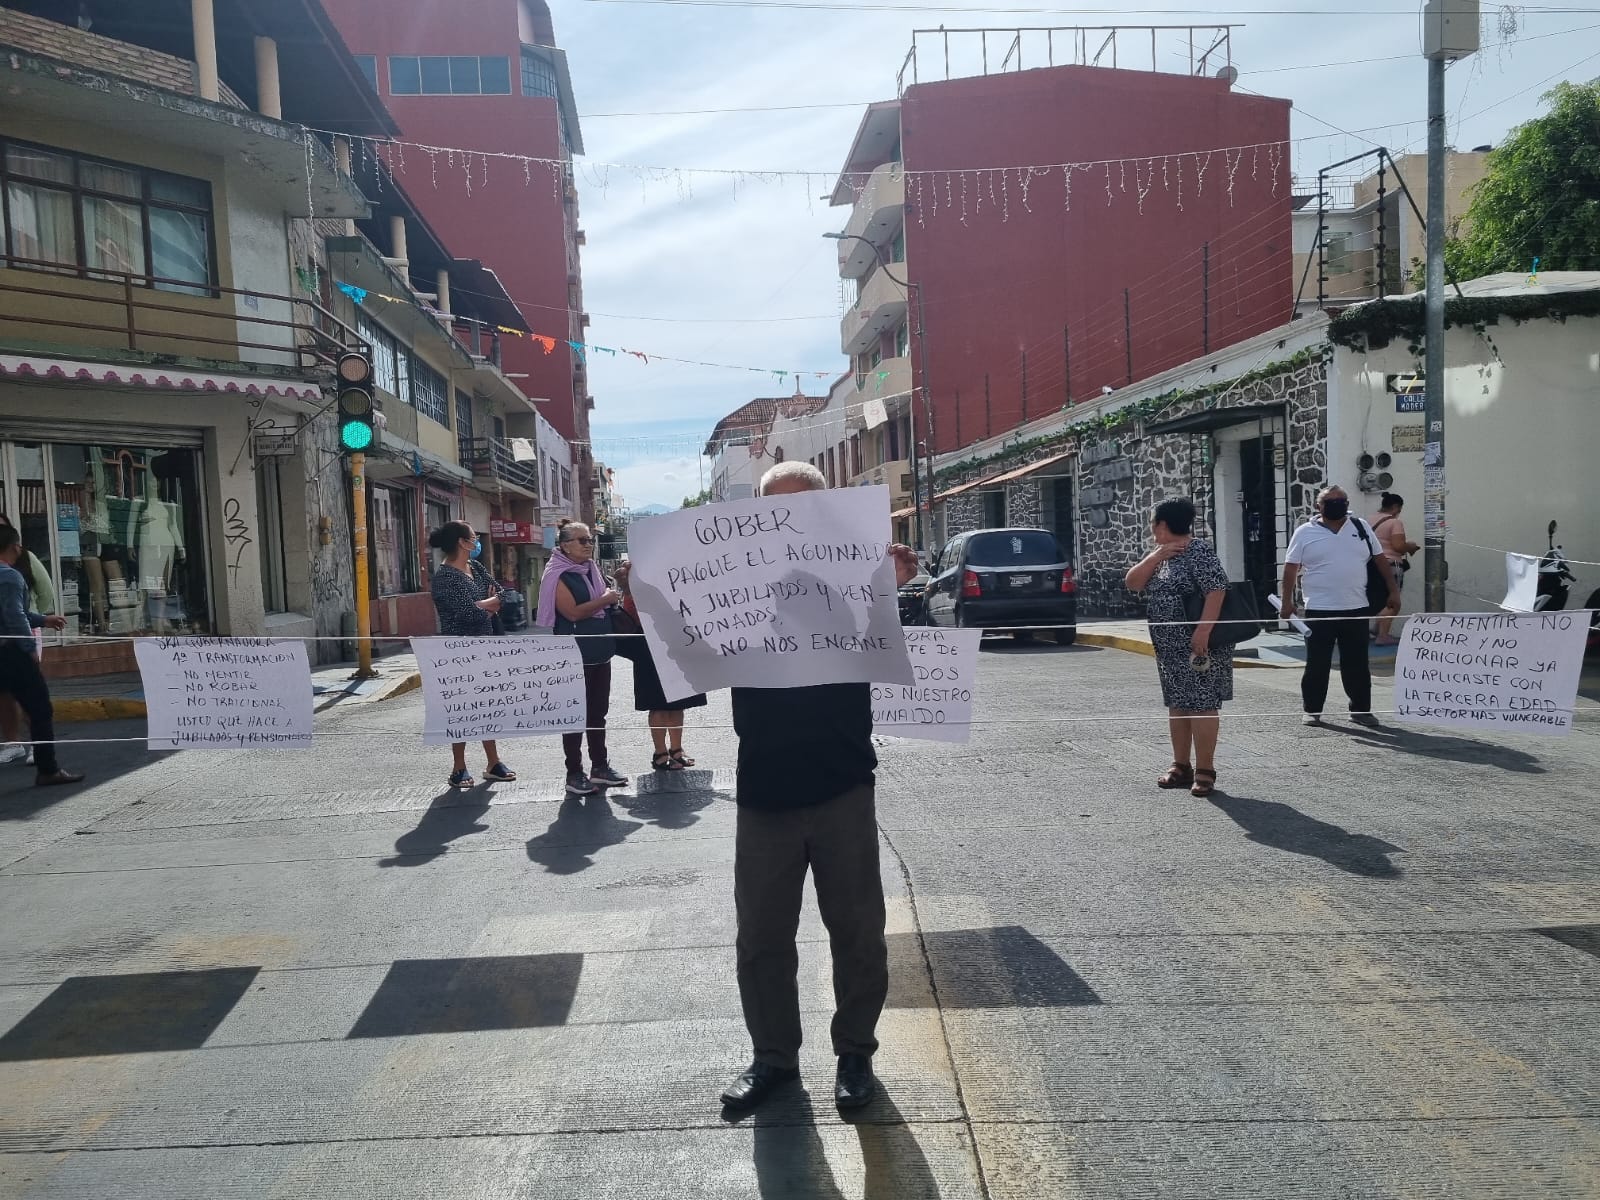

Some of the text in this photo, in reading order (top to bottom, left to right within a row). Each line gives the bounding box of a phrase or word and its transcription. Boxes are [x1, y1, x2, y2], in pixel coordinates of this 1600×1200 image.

[1401, 402, 1424, 411] MADER
[1403, 394, 1425, 402] CALLE
[694, 507, 805, 545] GOBER
[667, 552, 738, 592] PAGUE
[747, 548, 776, 567] EL
[678, 599, 691, 618] A
[1413, 615, 1442, 625] NO
[1450, 614, 1519, 632] MENTIR
[1541, 615, 1572, 631] NO
[720, 637, 748, 657] NO
[763, 635, 799, 653] NOS
[1411, 628, 1518, 650] ROBAR Y NO
[452, 655, 481, 668] QUE
[487, 648, 527, 659] PUEDA
[908, 644, 959, 655] TE DE
[1414, 647, 1557, 673] TRAICIONAR YA
[185, 670, 199, 680] NO
[205, 670, 252, 682] MENTIR
[438, 674, 474, 686] USTED
[482, 670, 501, 678] ES
[914, 665, 959, 681] DOS
[1403, 666, 1543, 691] LO APLICASTE CON
[185, 683, 204, 692] NO
[209, 682, 260, 691] ROBAR
[440, 673, 584, 700] BLE SOMOS UN GRUPO
[870, 687, 971, 701] OS NUESTRO
[187, 697, 207, 707] NO
[444, 693, 532, 712] VULNERABLE
[1405, 687, 1557, 712] LA TERCERA EDAD
[448, 698, 580, 725] EXIGIMOS EL PAGO DE
[871, 708, 945, 724] UINALDO
[1416, 705, 1468, 719] SECTOR
[1471, 711, 1496, 720] MAS
[1502, 713, 1567, 726] VULNERABLE
[177, 715, 293, 729] USTED QUE HACE A
[445, 716, 584, 739] NUESTRO AGUINALDO
[171, 730, 232, 745] JUBILADOS
